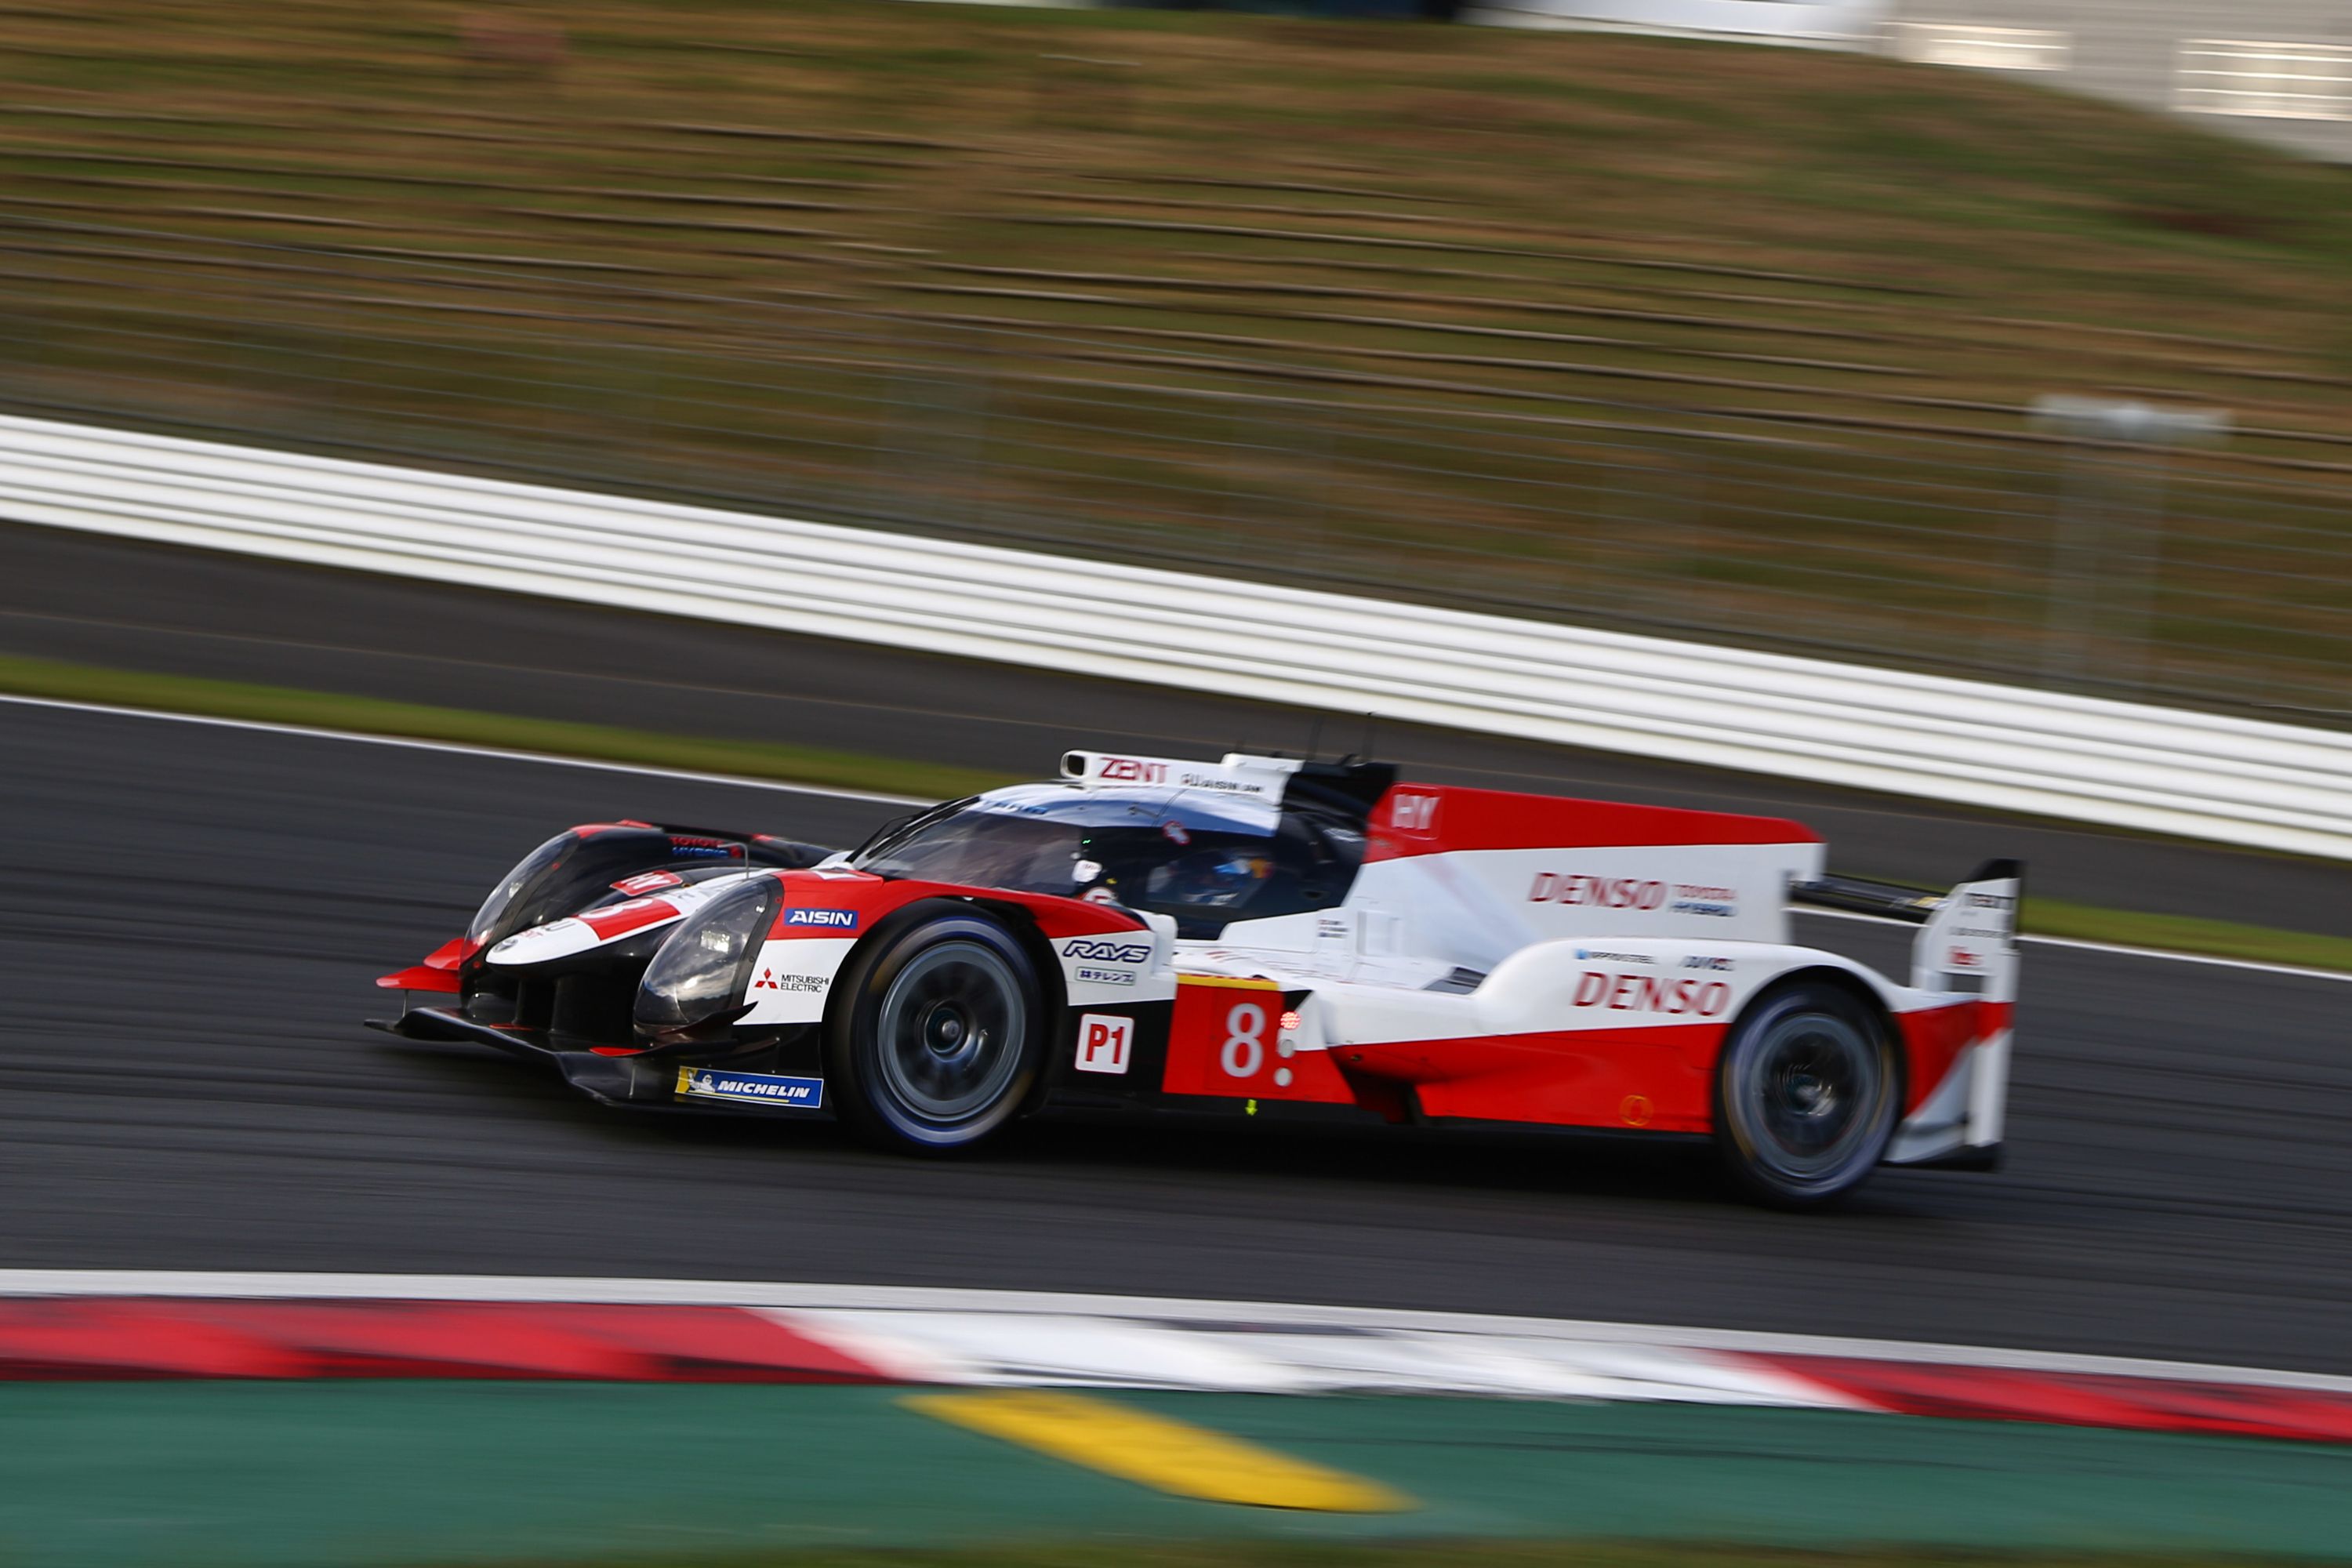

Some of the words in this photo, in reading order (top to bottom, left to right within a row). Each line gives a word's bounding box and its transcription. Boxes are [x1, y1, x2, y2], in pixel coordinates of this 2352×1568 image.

[1099, 757, 1169, 783] ZENT
[1392, 793, 1441, 829] HY
[620, 871, 673, 890] HY
[1529, 872, 1667, 910] DENSO
[789, 910, 853, 926] AISIN
[1062, 939, 1152, 964] RAYS
[781, 983, 822, 993] ELECTRIC
[782, 974, 829, 985] MITSUBISHI
[1570, 971, 1732, 1017] DENSO
[1086, 1023, 1125, 1065] P1
[1220, 1002, 1266, 1078] 8
[717, 1080, 811, 1098] MICHELIN
